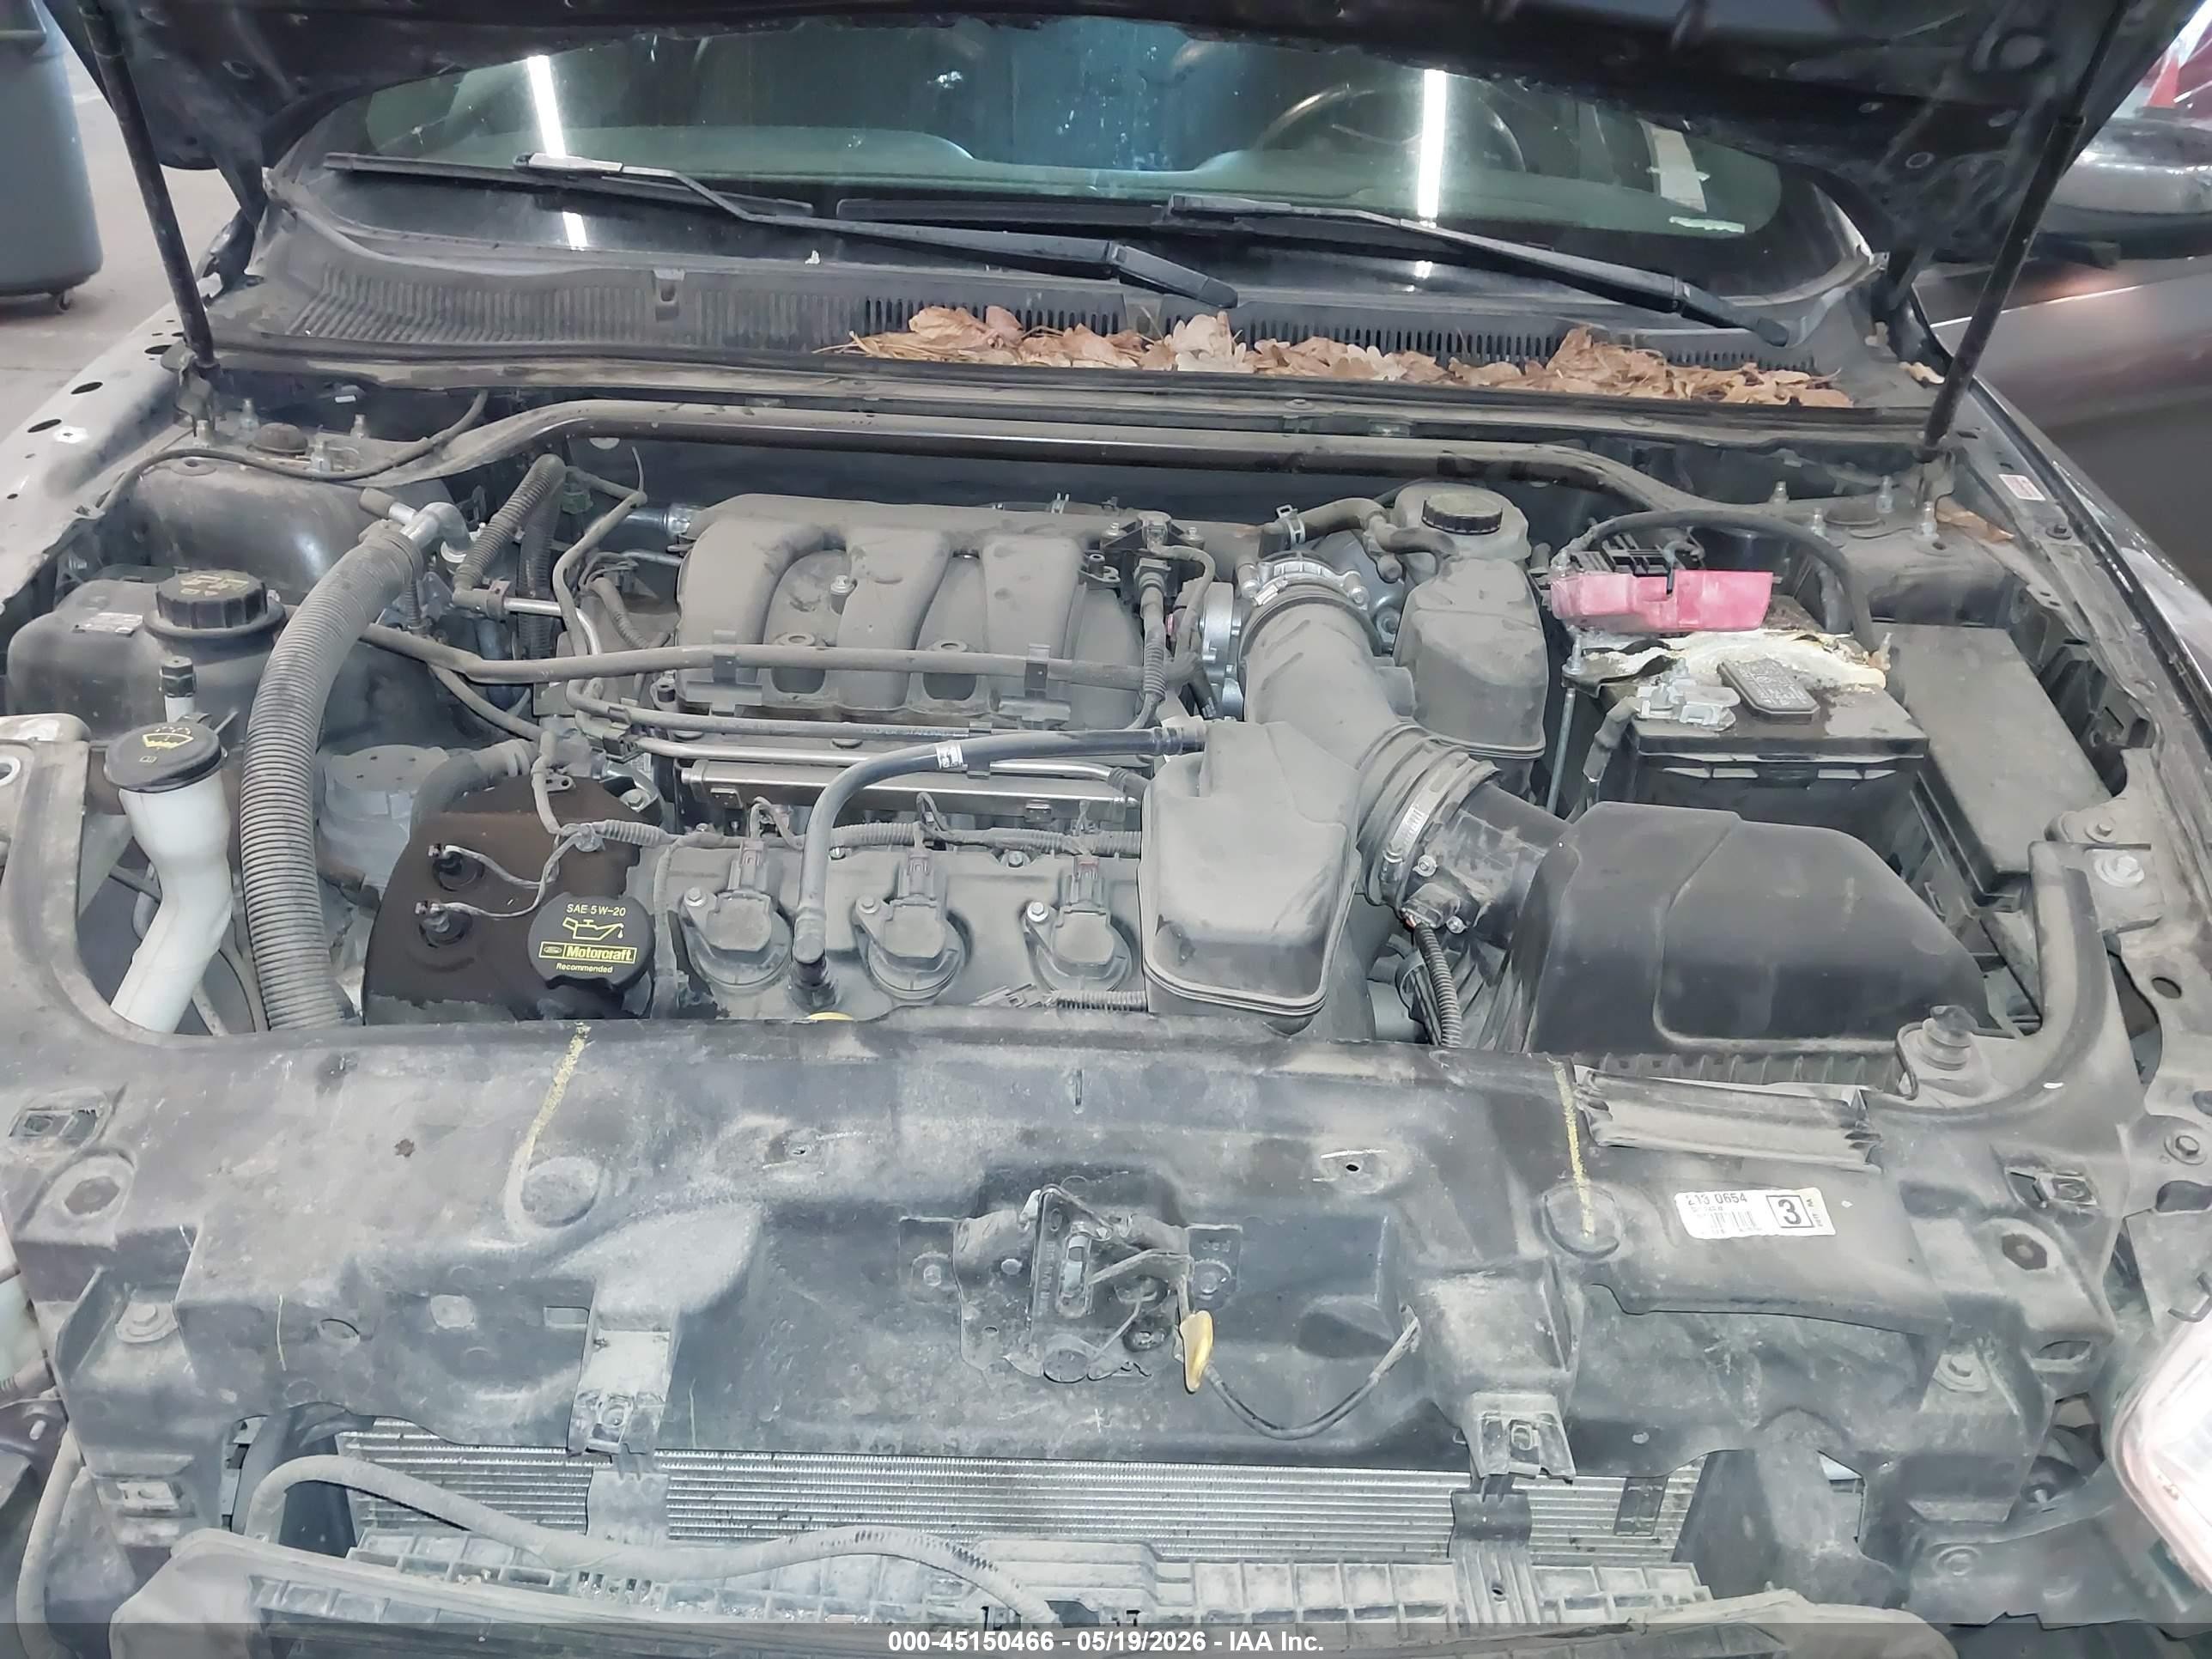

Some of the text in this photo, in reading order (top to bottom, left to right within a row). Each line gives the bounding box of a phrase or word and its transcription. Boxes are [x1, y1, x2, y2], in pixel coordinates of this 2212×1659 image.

[566, 903, 626, 917] SAE 5W-20
[566, 945, 632, 962] Motorcraft
[556, 962, 613, 974] Recommended
[1714, 1192, 1748, 1205] 0654
[1778, 1199, 1802, 1225] 3
